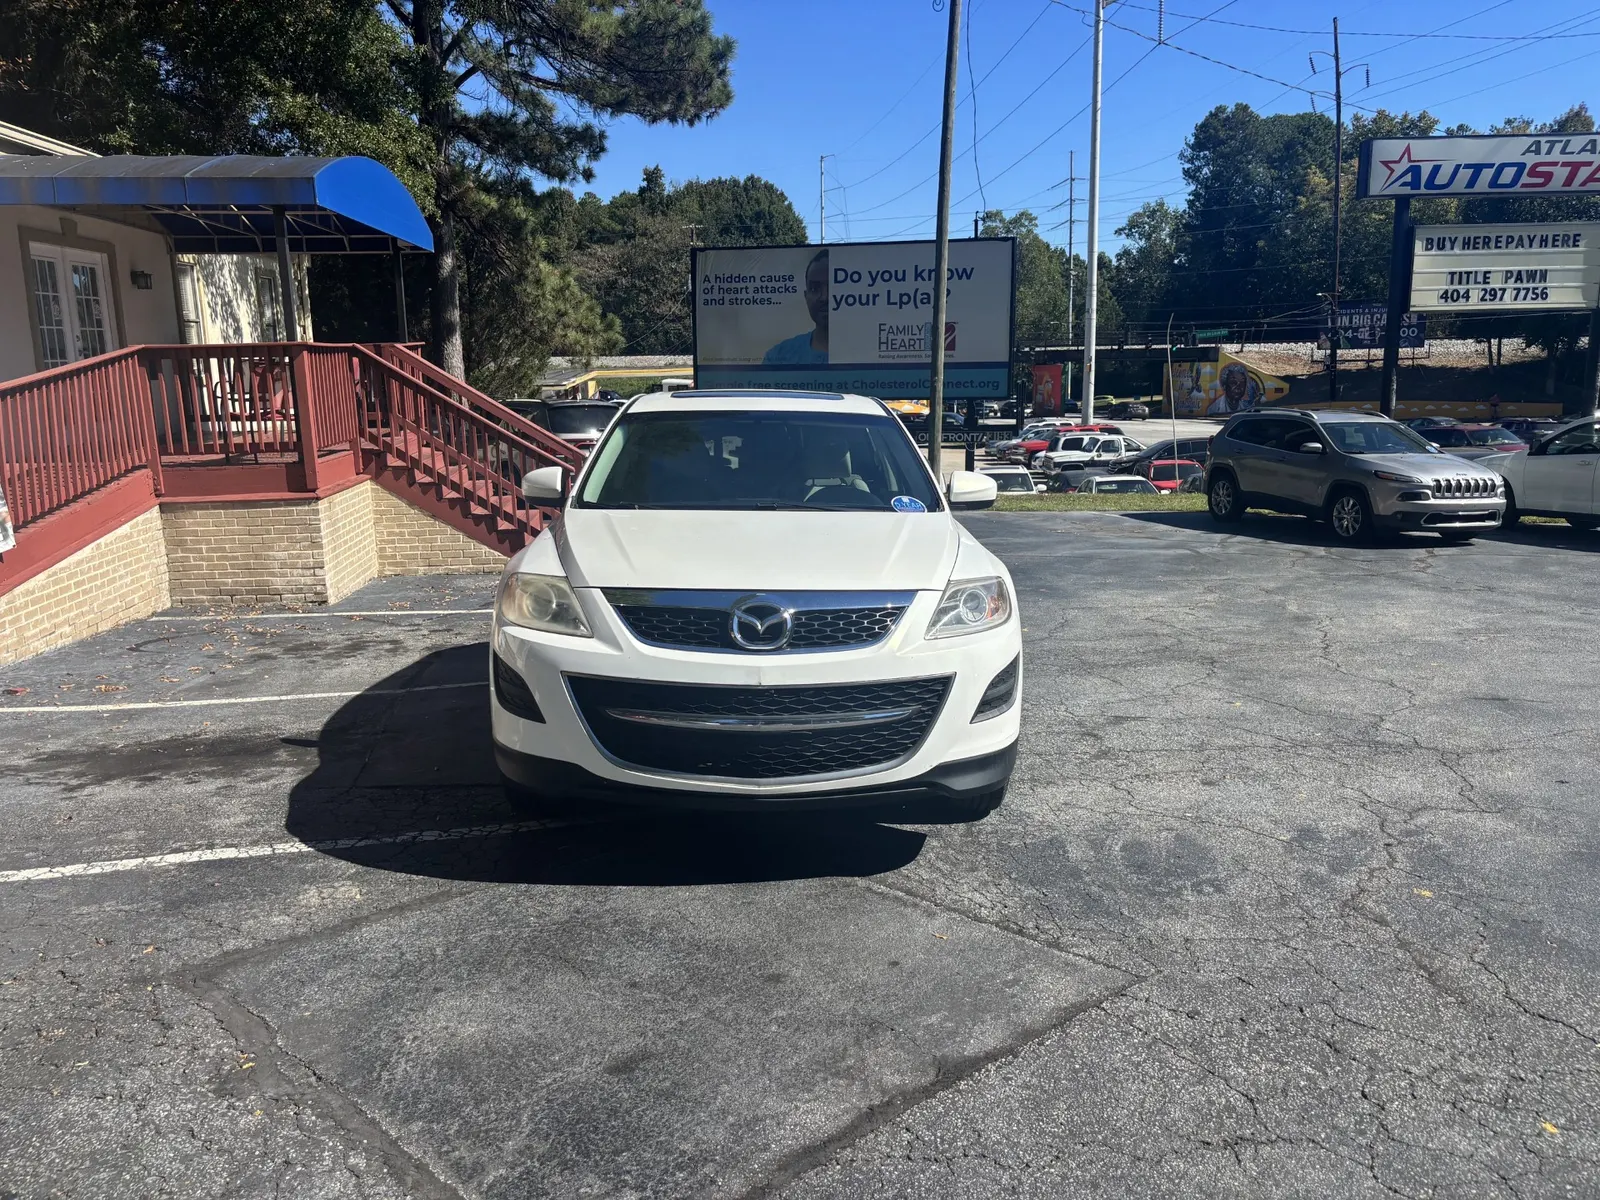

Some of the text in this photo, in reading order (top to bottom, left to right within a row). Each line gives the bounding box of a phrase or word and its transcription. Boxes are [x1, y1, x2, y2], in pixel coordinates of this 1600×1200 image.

[1521, 139, 1600, 156] ATLA
[1424, 233, 1582, 251] BUY HERE PAY HERE
[702, 273, 795, 284] A hidden cause
[833, 267, 862, 284] Do
[867, 269, 907, 287] you
[1448, 269, 1548, 285] TITLE PAWN
[702, 284, 798, 295] of heart attacks
[1439, 287, 1549, 303] 404 297 7756
[702, 295, 782, 306] and strokes...
[832, 293, 880, 311] your
[878, 323, 925, 336] FAMILY
[878, 336, 925, 350] HEART
[774, 380, 833, 392] screening
[836, 380, 848, 390] at
[852, 379, 1000, 391] CholesterolCnnect.org
